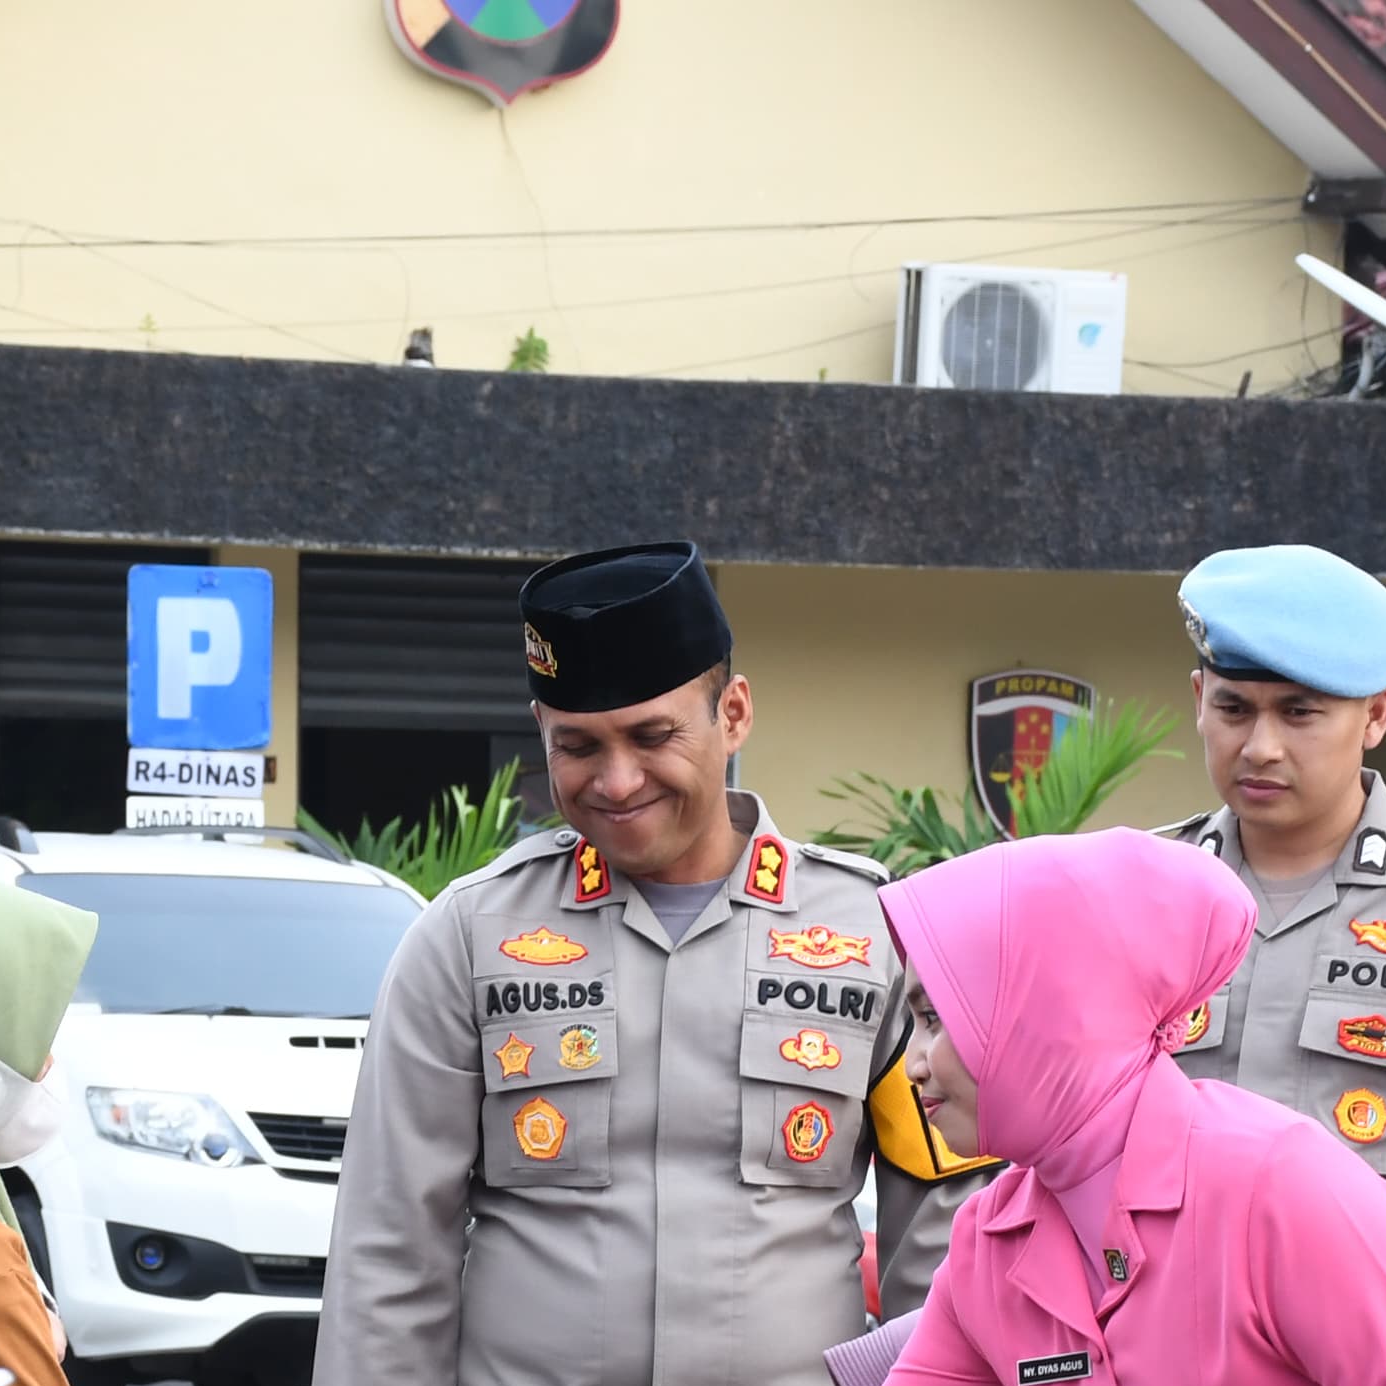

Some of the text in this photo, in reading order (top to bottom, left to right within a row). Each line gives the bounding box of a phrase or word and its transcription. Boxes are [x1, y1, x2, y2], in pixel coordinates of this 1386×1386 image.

[157, 597, 242, 719] P
[995, 676, 1075, 698] PROPAM
[134, 760, 257, 788] R4-DINAS
[200, 811, 255, 827] UTARA
[486, 981, 605, 1017] AGUS.DS
[758, 978, 876, 1022] POLRI
[1060, 1360, 1083, 1372] AGUS
